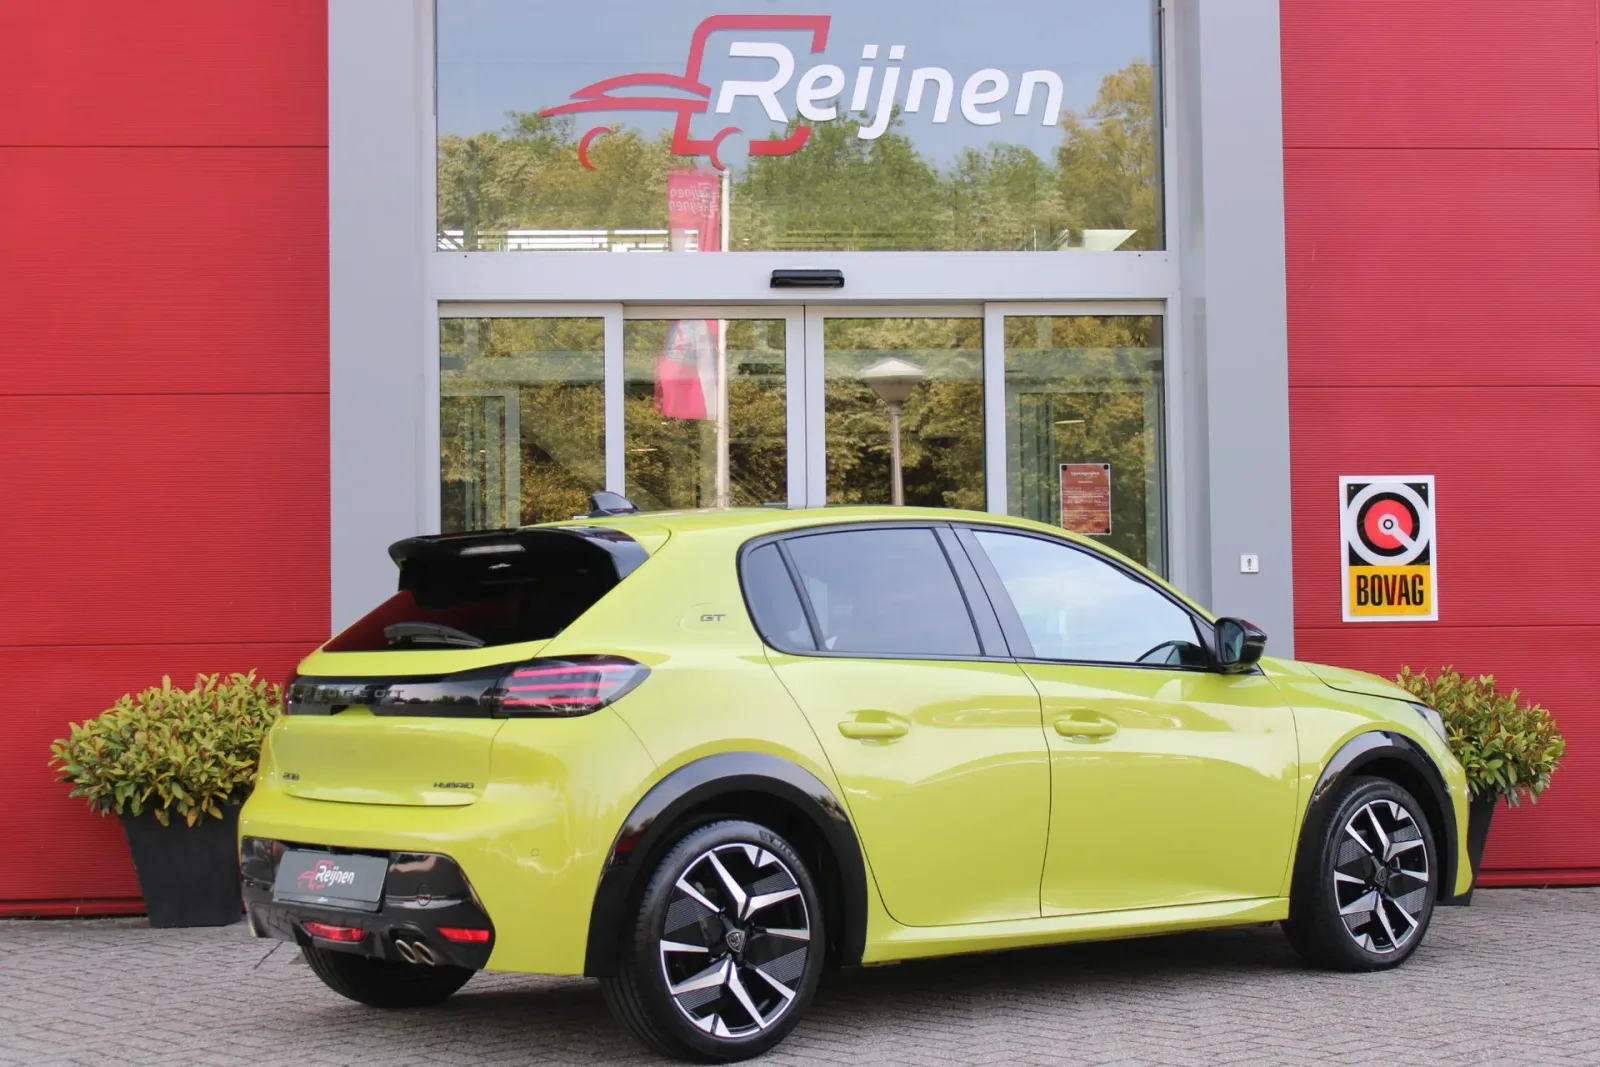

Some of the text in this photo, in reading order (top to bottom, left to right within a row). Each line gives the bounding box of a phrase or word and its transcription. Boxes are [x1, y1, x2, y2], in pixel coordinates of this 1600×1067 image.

[714, 41, 1064, 140] Reijnen
[1356, 574, 1424, 606] BOVAG
[700, 614, 726, 622] GT
[283, 771, 300, 781] 208
[315, 864, 355, 887] Reijnen
